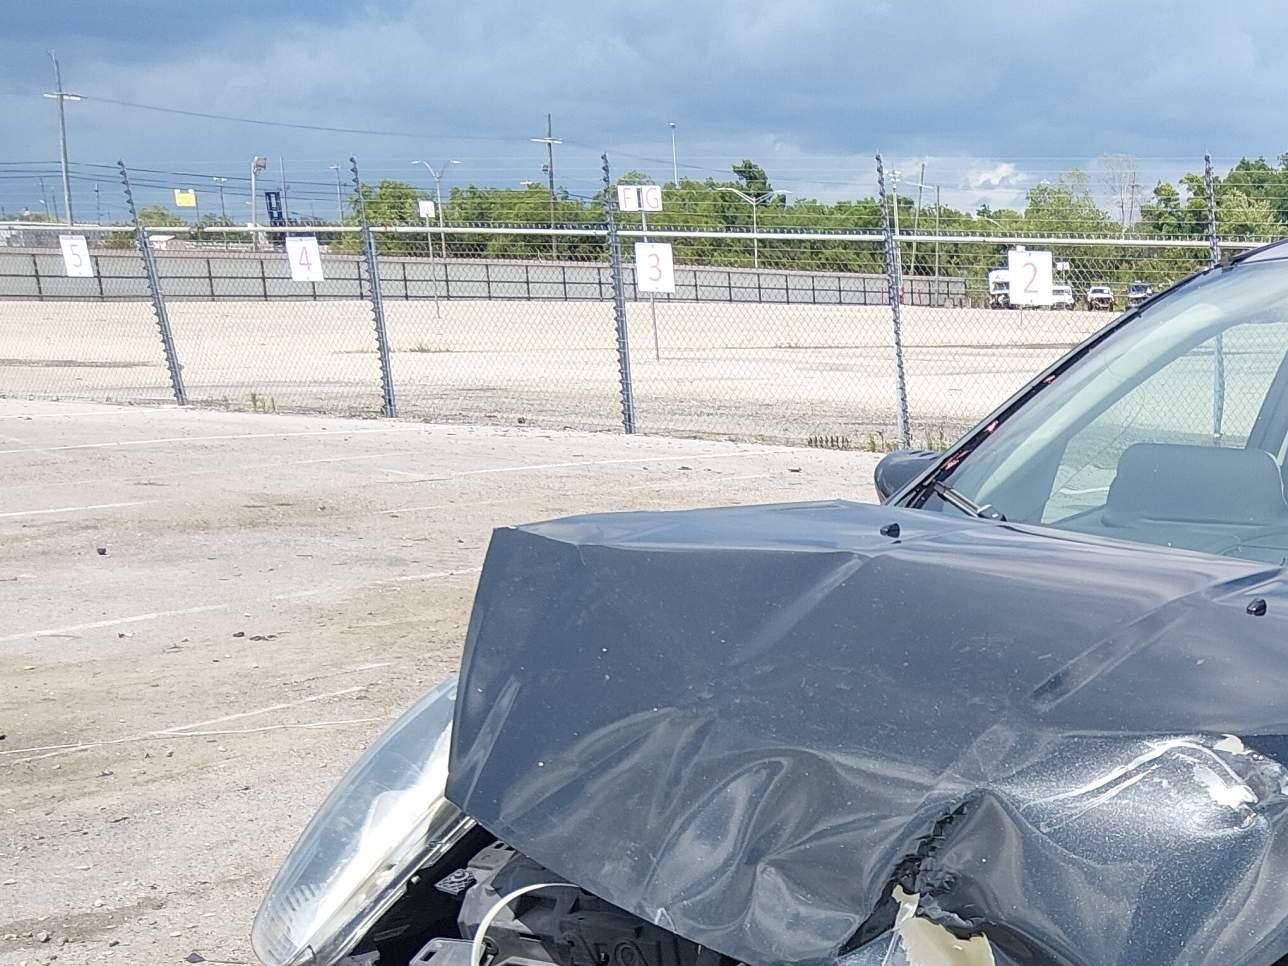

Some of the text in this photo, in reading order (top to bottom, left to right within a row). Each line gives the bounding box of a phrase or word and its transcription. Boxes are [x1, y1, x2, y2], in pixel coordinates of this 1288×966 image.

[622, 187, 660, 209] F G
[69, 243, 82, 268] 5
[299, 245, 313, 272] 4
[647, 253, 663, 282] 3
[1022, 262, 1040, 294] 2
